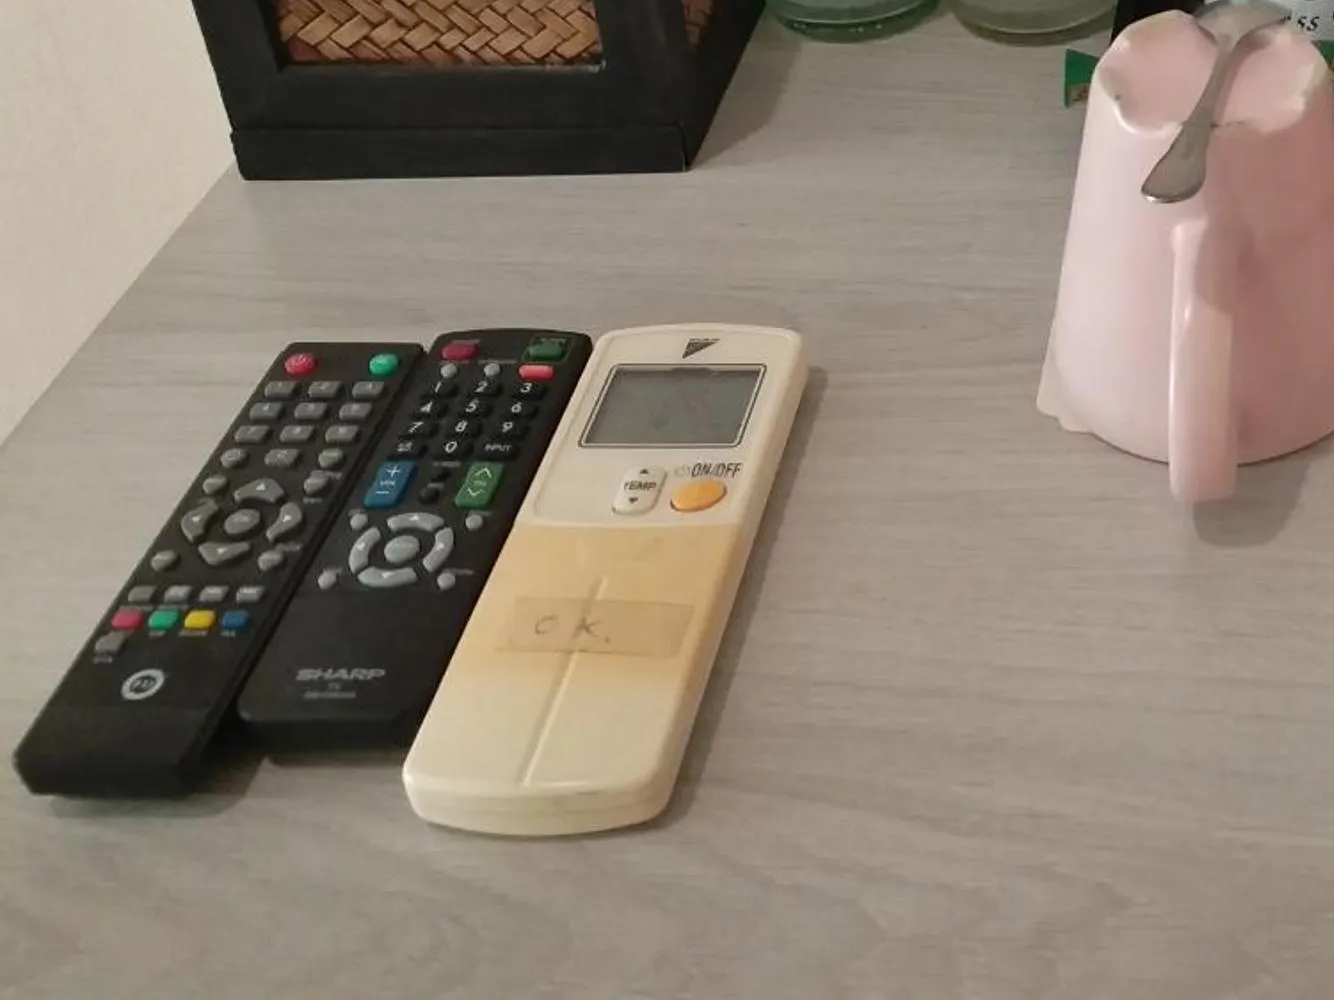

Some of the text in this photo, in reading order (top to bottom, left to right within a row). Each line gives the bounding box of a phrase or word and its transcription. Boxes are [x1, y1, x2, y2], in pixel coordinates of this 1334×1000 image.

[474, 380, 489, 393] 2
[519, 382, 533, 393] 3
[465, 399, 480, 413] 5
[510, 402, 523, 414] 6
[454, 420, 468, 433] 8
[501, 421, 514, 433] 9
[690, 462, 743, 478] ON/OFF
[623, 480, 657, 491] TEMP
[296, 668, 387, 681] SHARP
